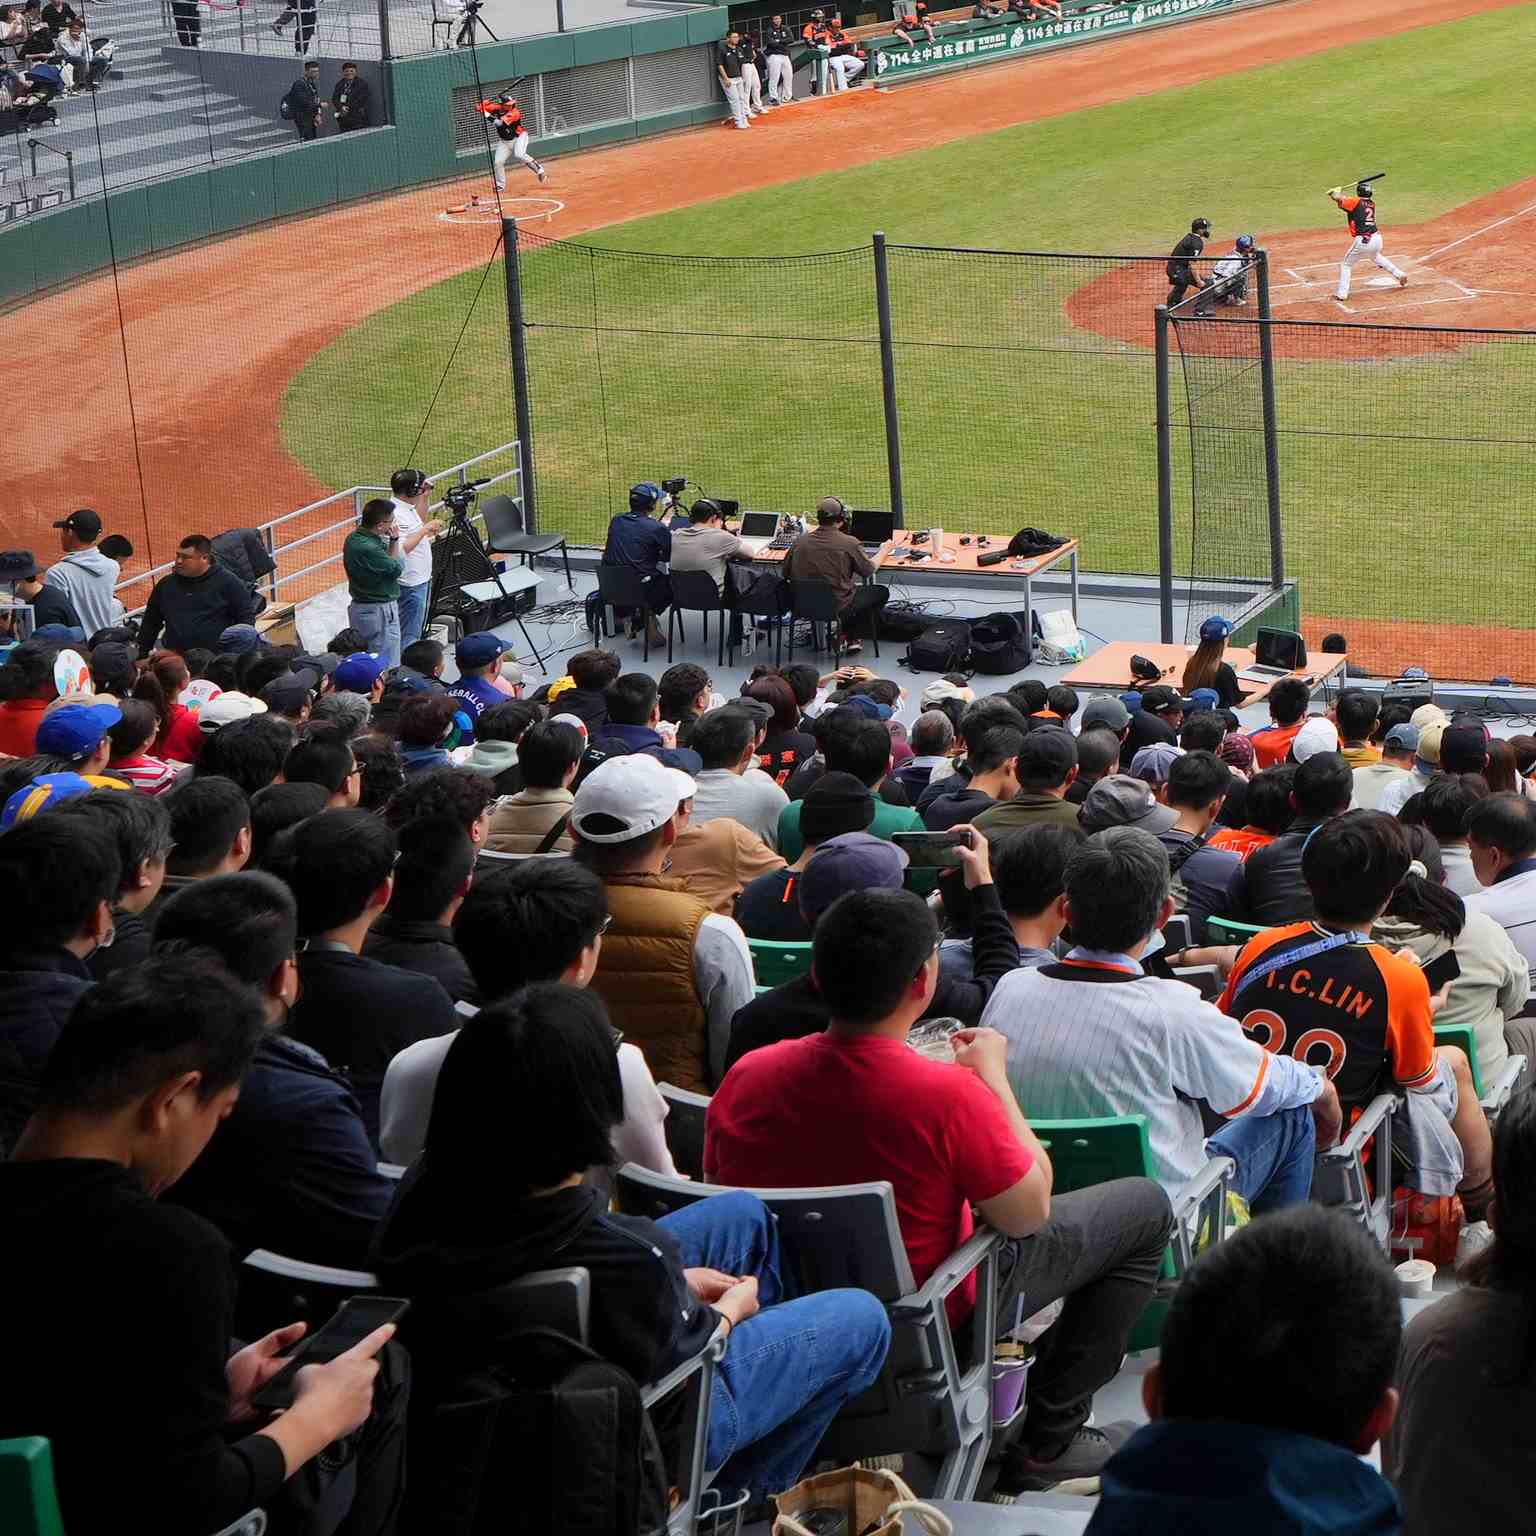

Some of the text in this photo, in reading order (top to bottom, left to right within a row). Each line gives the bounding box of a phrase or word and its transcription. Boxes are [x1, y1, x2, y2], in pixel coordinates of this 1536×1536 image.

[890, 39, 975, 67] 114全中運在臺南
[1365, 207, 1373, 222] 2
